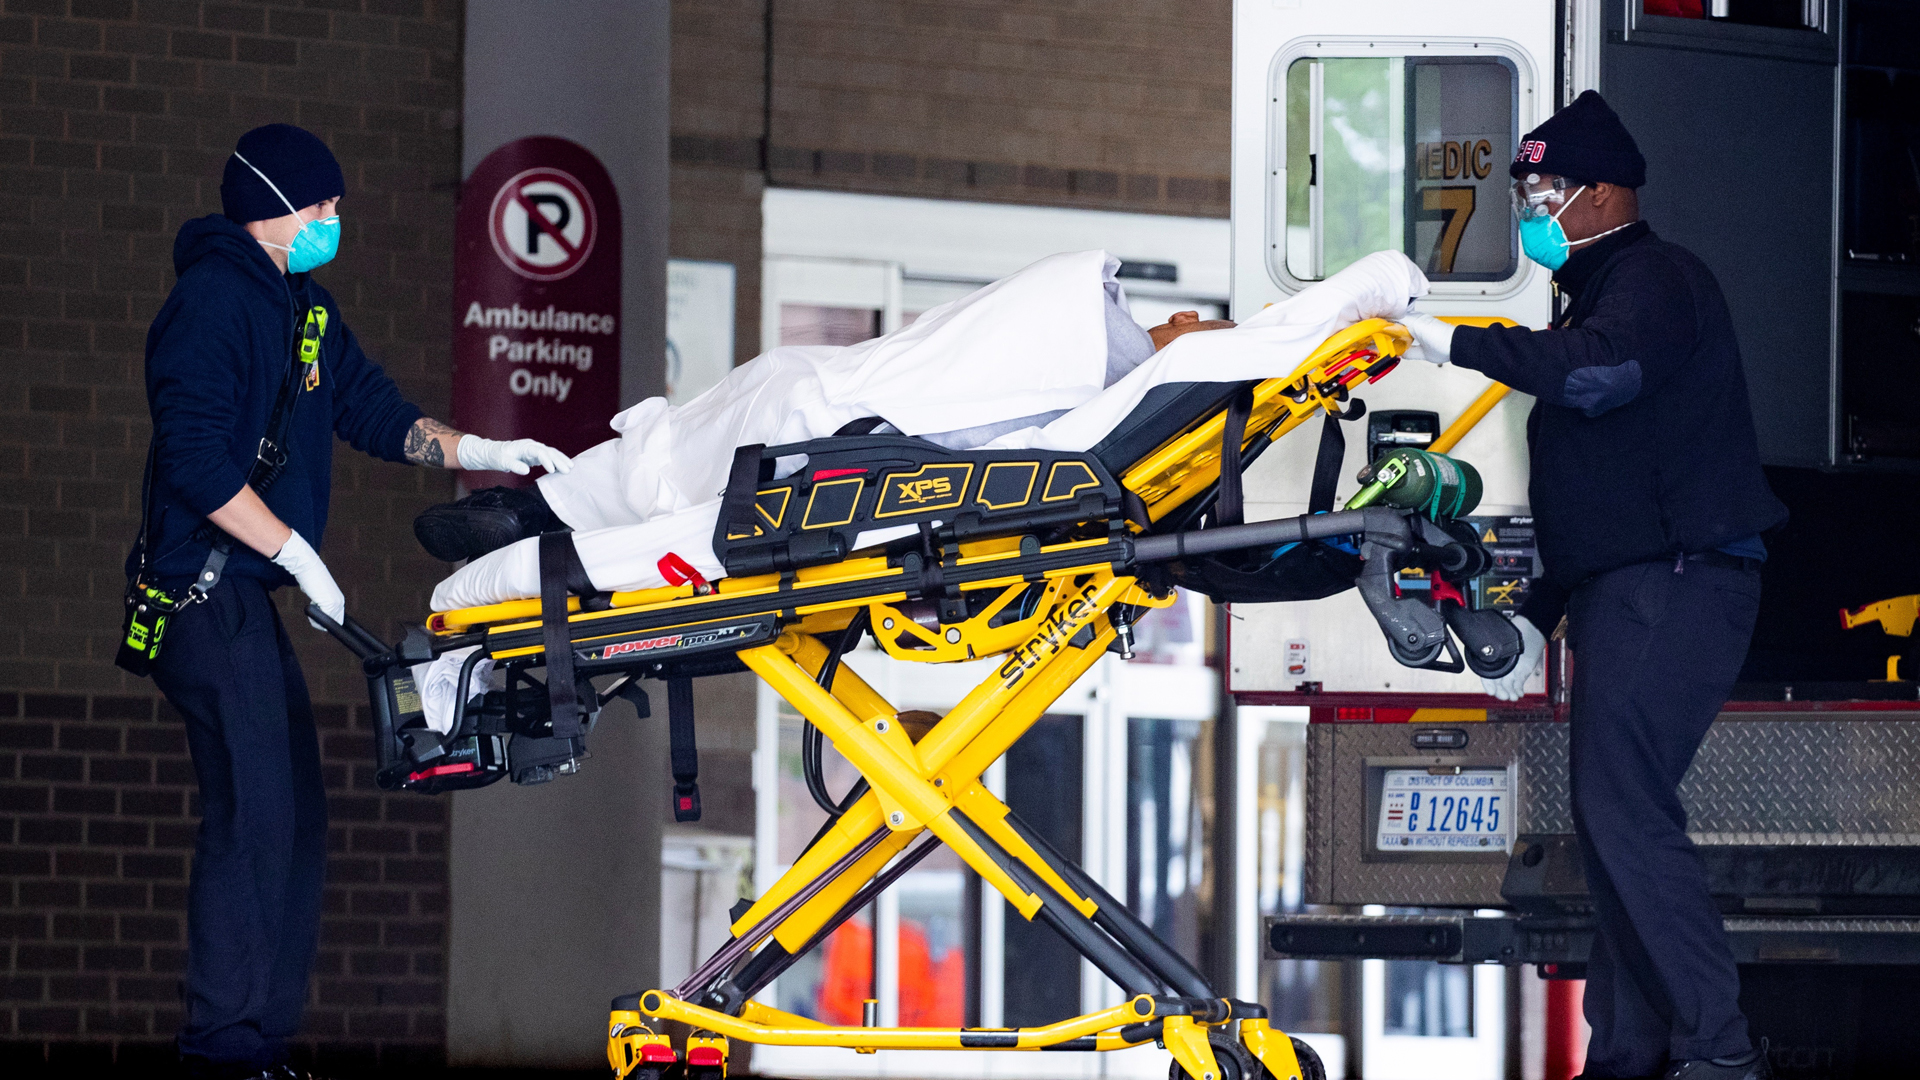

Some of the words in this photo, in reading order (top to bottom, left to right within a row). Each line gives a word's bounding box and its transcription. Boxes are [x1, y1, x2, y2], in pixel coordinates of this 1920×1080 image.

[1416, 185, 1476, 273] 7
[463, 301, 615, 335] Ambulance
[488, 335, 594, 372] Parking
[509, 369, 573, 403] Only
[897, 476, 952, 500] XPS
[1000, 585, 1097, 690] stryker
[1408, 776, 1441, 786] DISTRICT
[1443, 776, 1454, 786] OF
[1455, 776, 1494, 786] COLUMBIA
[1426, 796, 1500, 832] 12645
